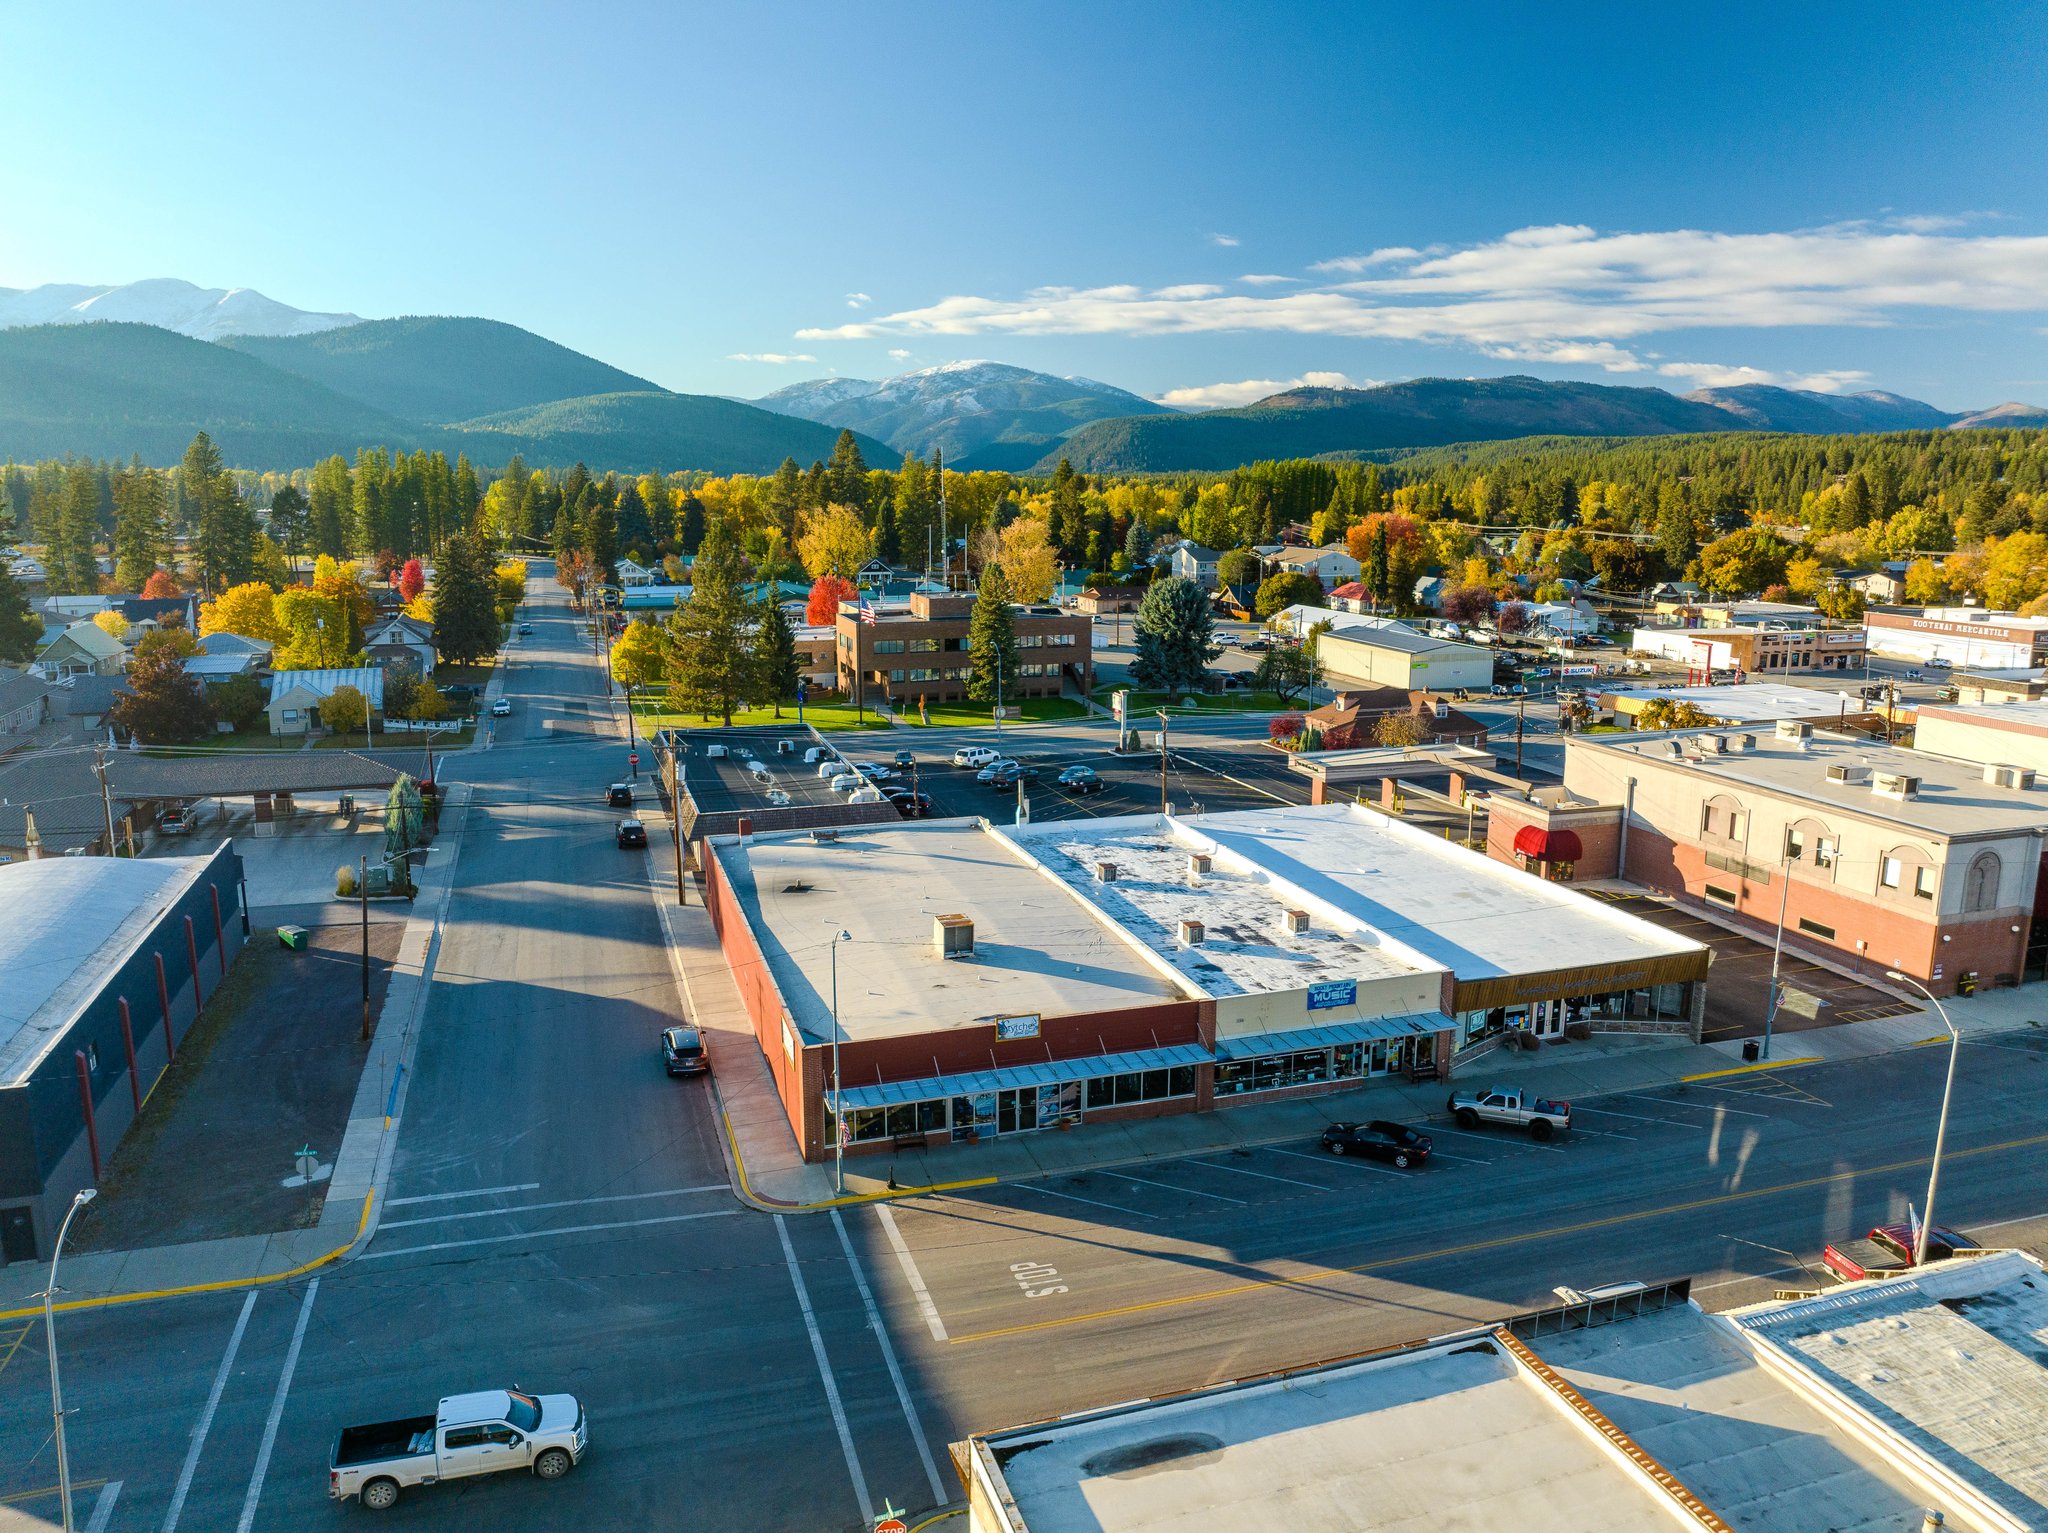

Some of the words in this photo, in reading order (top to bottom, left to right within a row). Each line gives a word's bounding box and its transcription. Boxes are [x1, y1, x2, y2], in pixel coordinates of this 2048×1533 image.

[1912, 620, 1953, 631] KOOTENAI
[1956, 624, 2010, 637] MERCANTILE
[1314, 990, 1351, 1002] MUSIC
[1010, 1262, 1068, 1298] STOP
